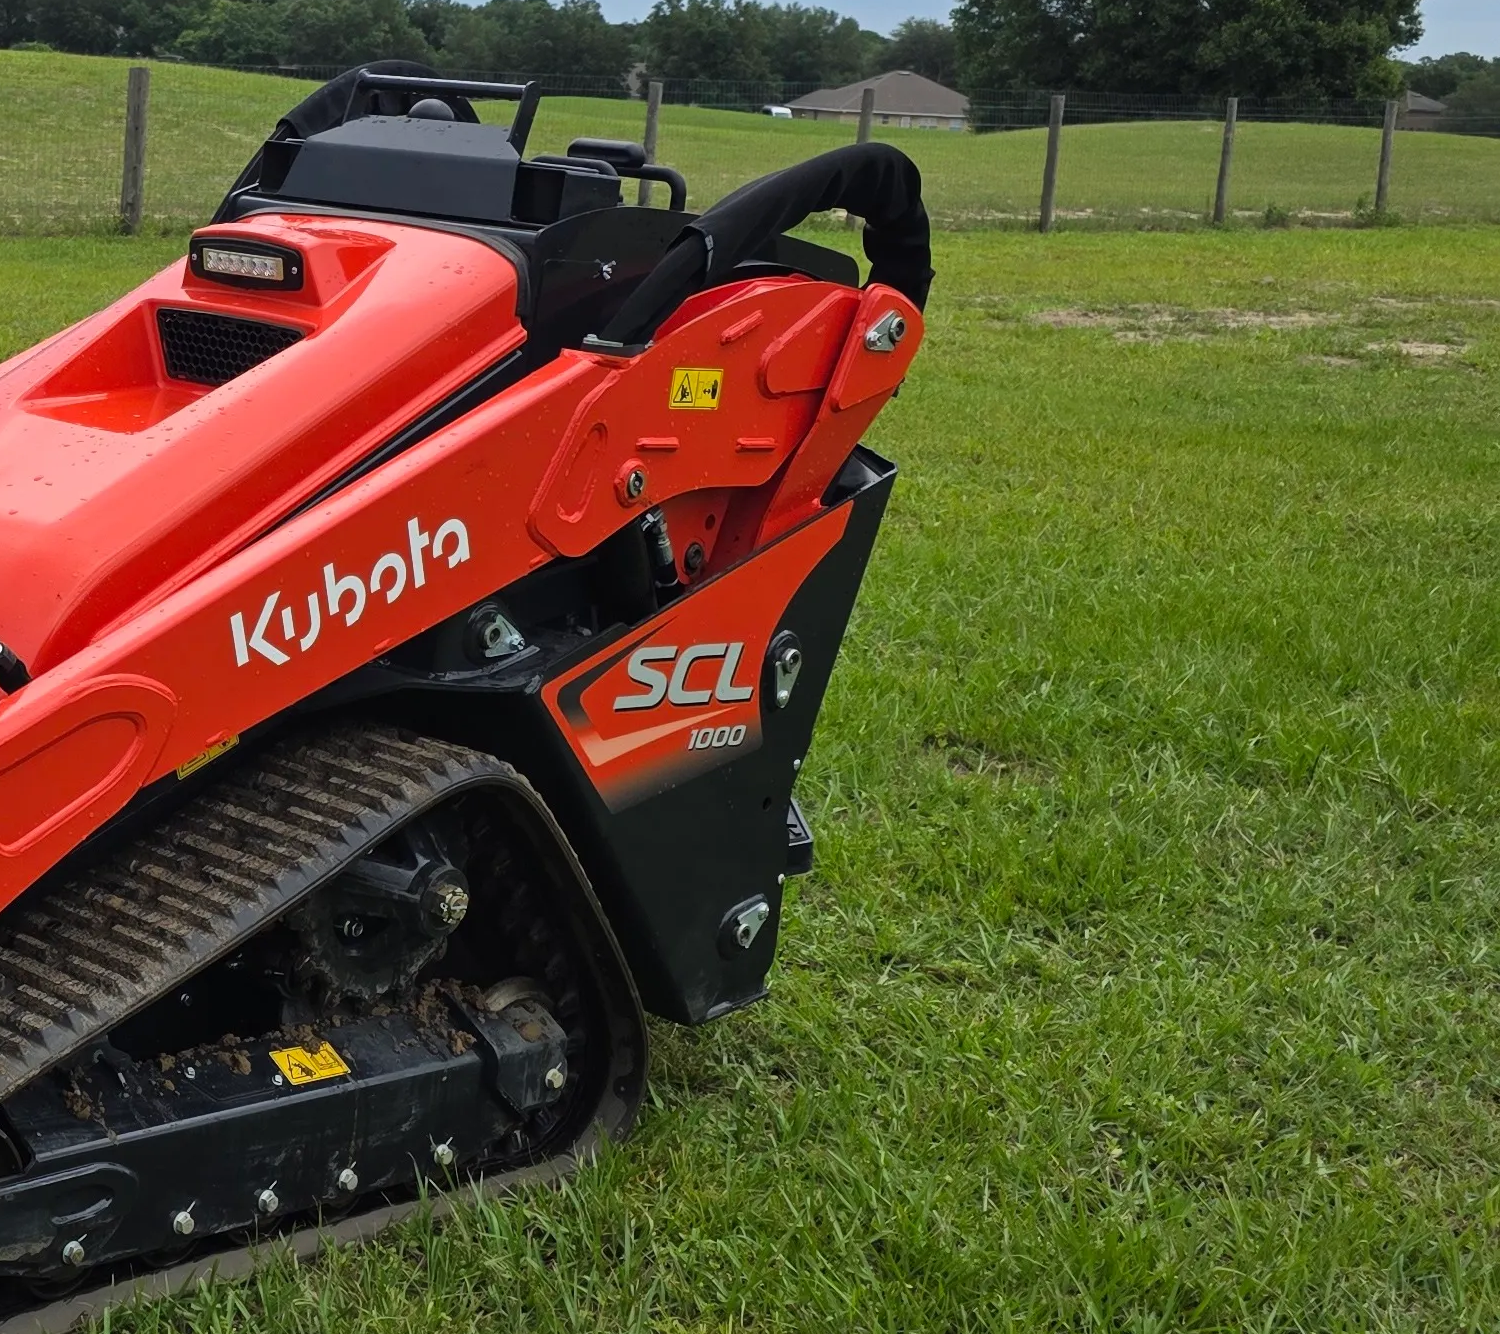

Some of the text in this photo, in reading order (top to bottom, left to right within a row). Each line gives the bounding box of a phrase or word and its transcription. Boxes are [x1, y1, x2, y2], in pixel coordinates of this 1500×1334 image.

[230, 517, 471, 667] Kubota
[613, 642, 754, 710] SCL
[687, 724, 746, 750] 1000
